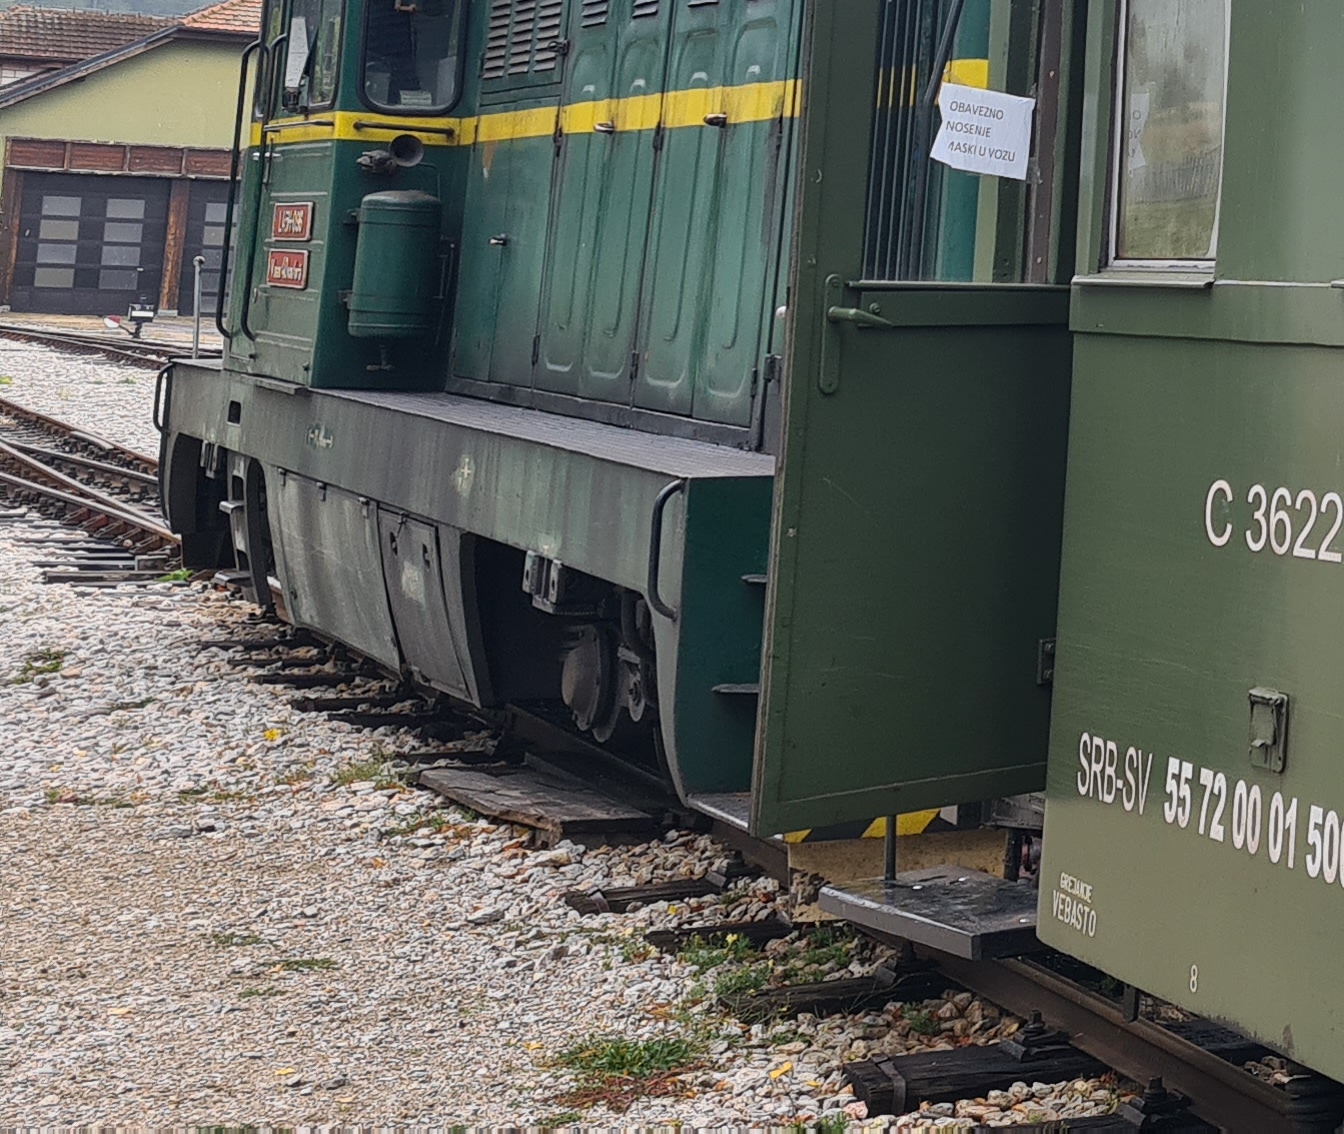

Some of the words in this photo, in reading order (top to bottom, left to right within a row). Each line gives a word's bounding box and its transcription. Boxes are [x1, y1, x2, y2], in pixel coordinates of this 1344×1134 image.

[950, 101, 1004, 120] OBAVEZNO
[946, 121, 992, 138] NOSENJE
[979, 146, 987, 156] U
[988, 148, 1015, 161] VOZU
[1205, 479, 1233, 547] C
[1245, 484, 1344, 563] 3622
[1077, 732, 1153, 816] SRB-SV
[1163, 756, 1193, 829] 55
[1198, 767, 1227, 843] 72
[1232, 779, 1262, 855] 00
[1268, 791, 1298, 869] 01
[1060, 872, 1093, 903] GREJANJE
[1053, 889, 1097, 937] VEBASTO
[1189, 964, 1198, 993] 8
